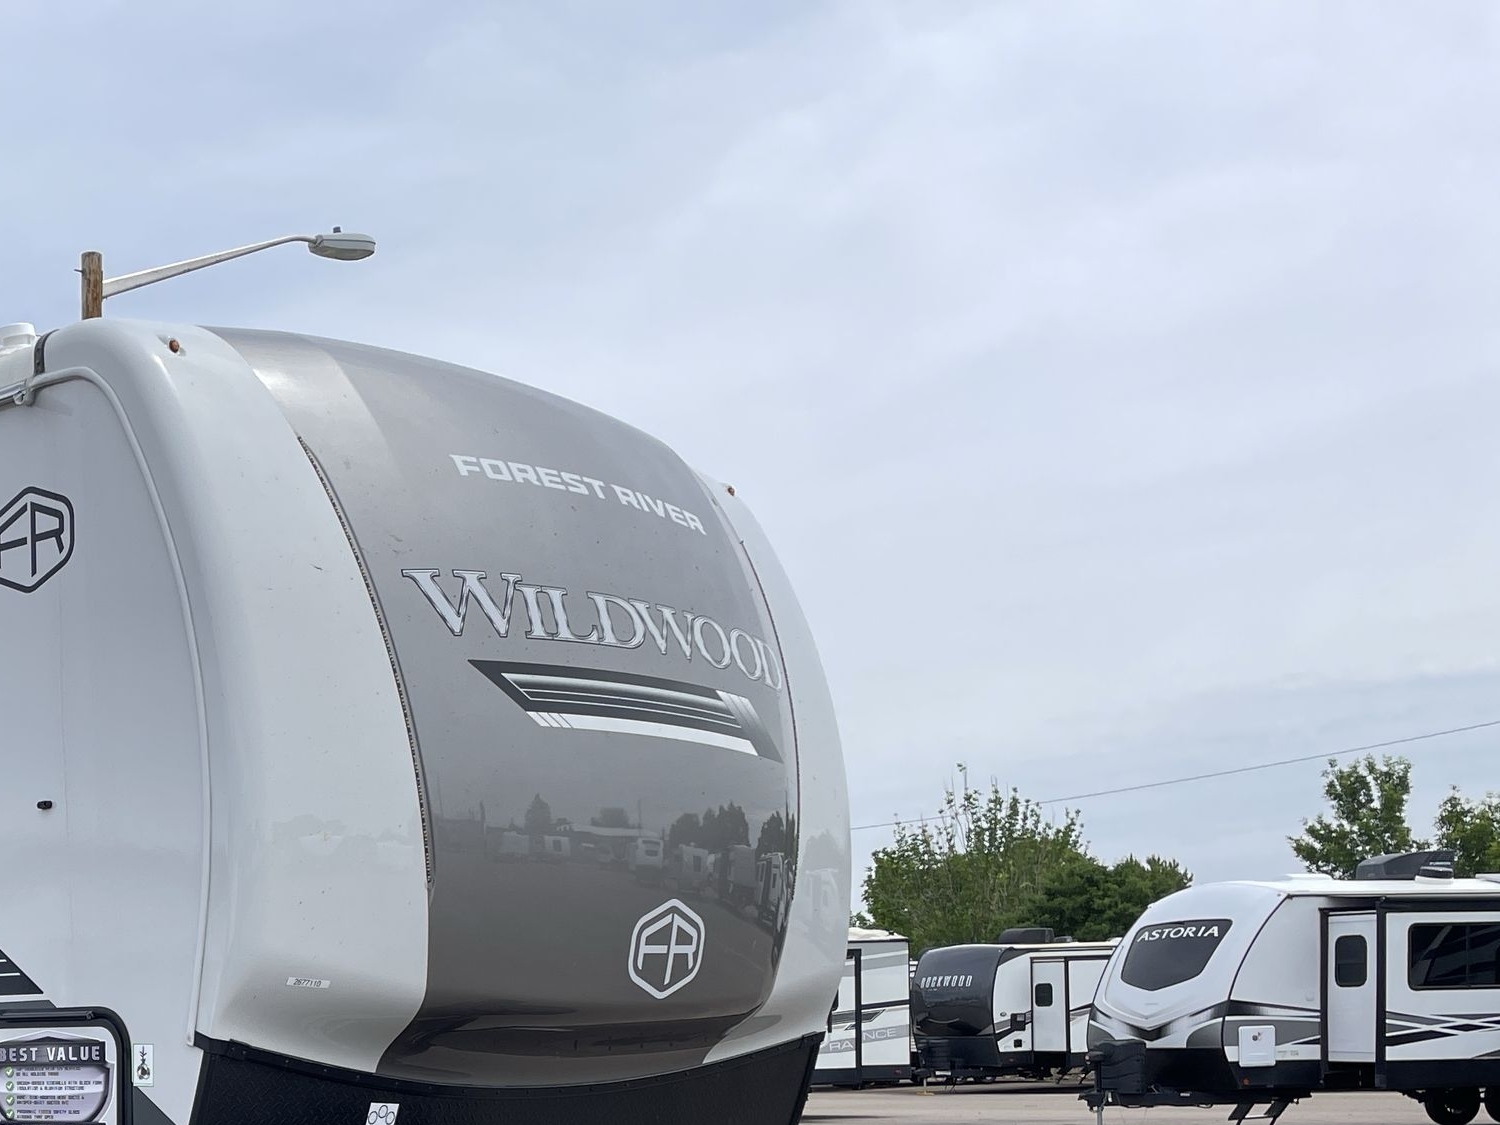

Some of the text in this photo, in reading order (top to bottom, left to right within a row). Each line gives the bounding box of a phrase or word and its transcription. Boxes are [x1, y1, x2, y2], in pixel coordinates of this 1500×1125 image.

[449, 453, 708, 536] FOREST RIVER
[400, 567, 783, 692] WILDWOOD
[1136, 925, 1219, 943] ASTORIA
[46, 1045, 100, 1061] VALUE
